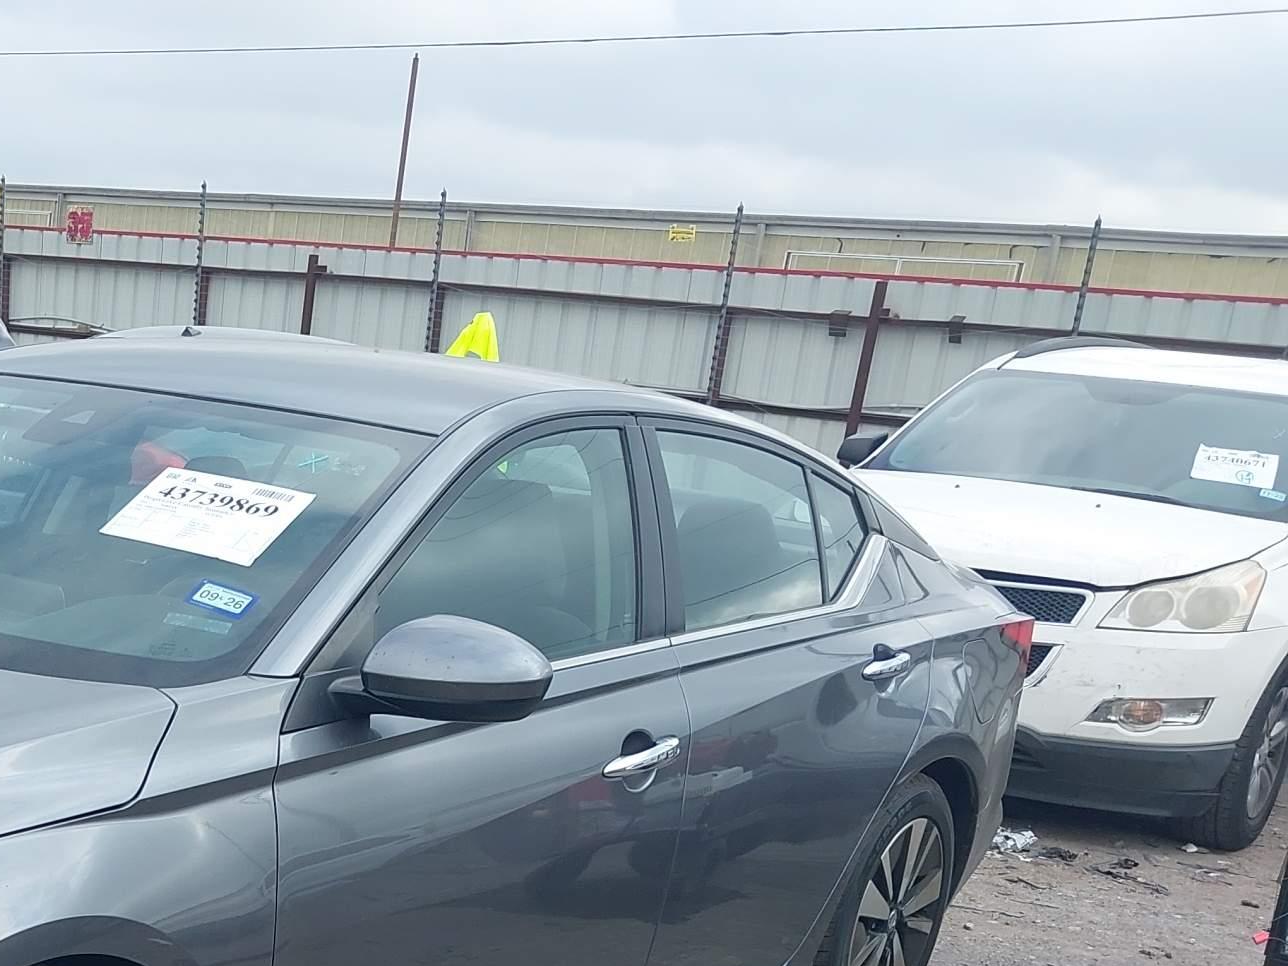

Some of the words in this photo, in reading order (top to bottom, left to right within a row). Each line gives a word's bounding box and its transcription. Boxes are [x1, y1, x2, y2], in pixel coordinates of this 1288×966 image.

[158, 485, 280, 518] 43739869
[199, 589, 220, 602] 09
[223, 597, 245, 610] 26
